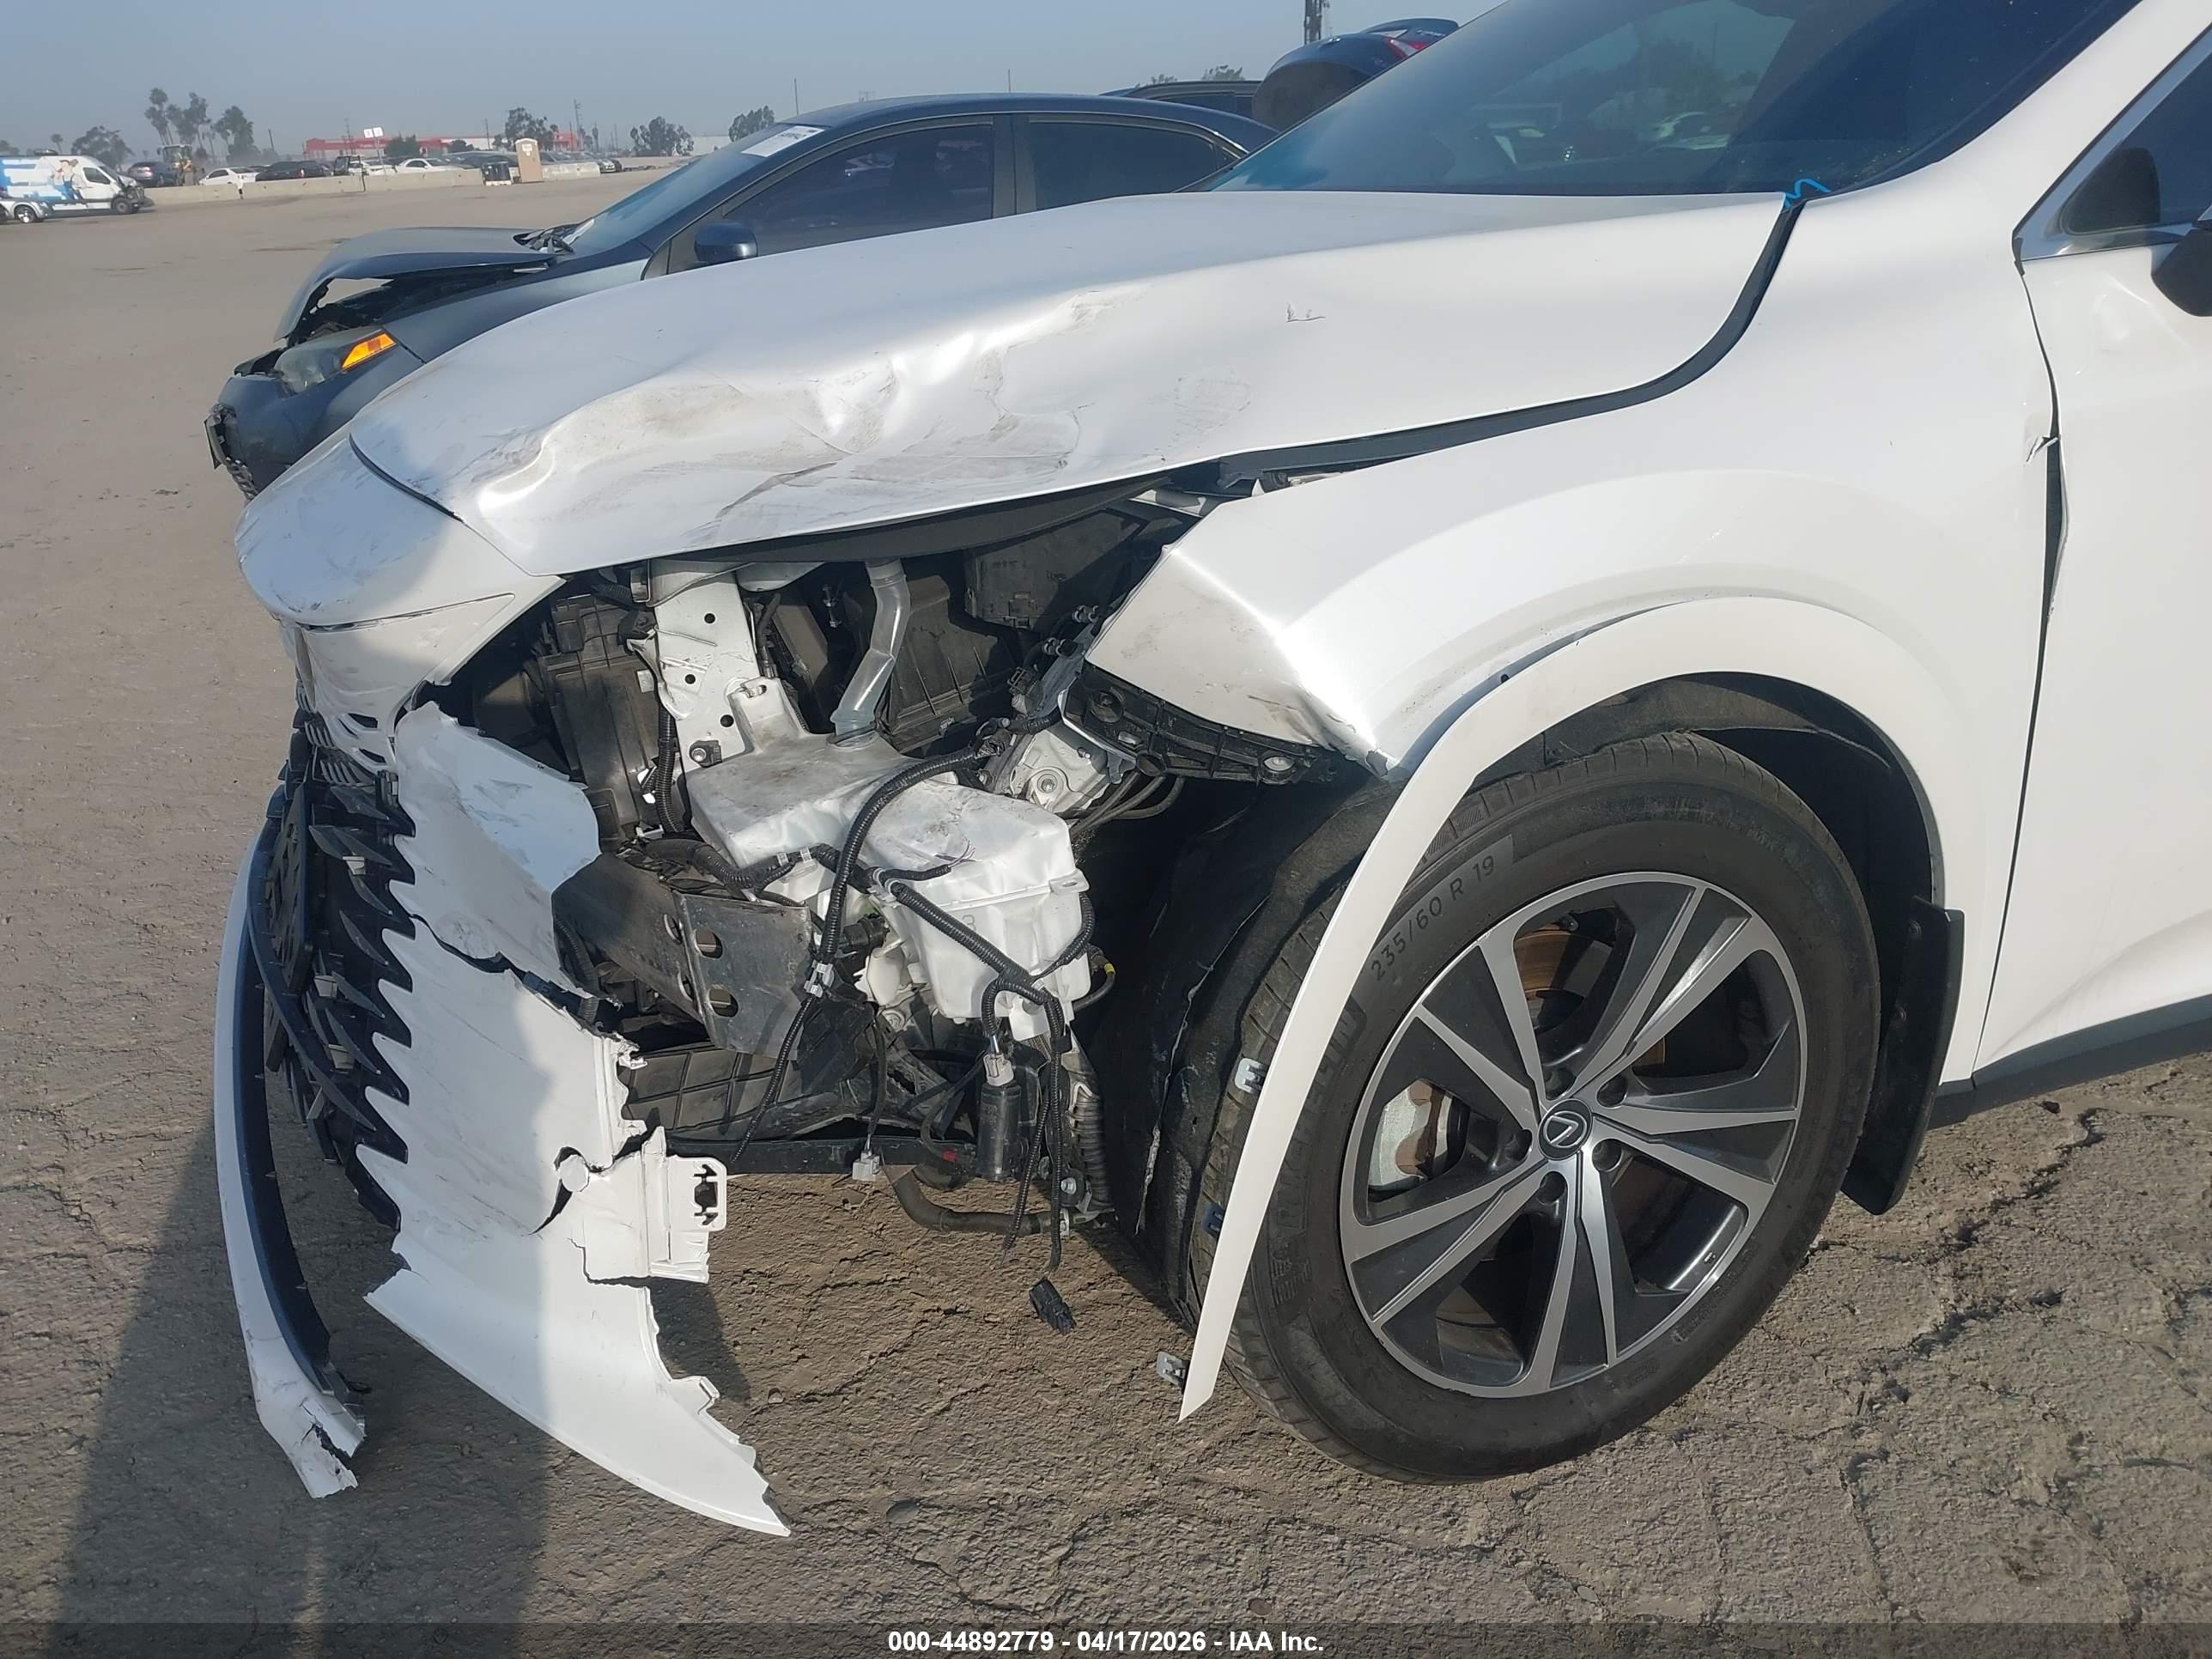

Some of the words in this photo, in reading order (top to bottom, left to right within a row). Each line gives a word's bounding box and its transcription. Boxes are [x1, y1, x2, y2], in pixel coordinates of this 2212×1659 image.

[1370, 896, 1443, 981] 235/60
[1449, 877, 1465, 901] R
[1472, 854, 1495, 883] 19
